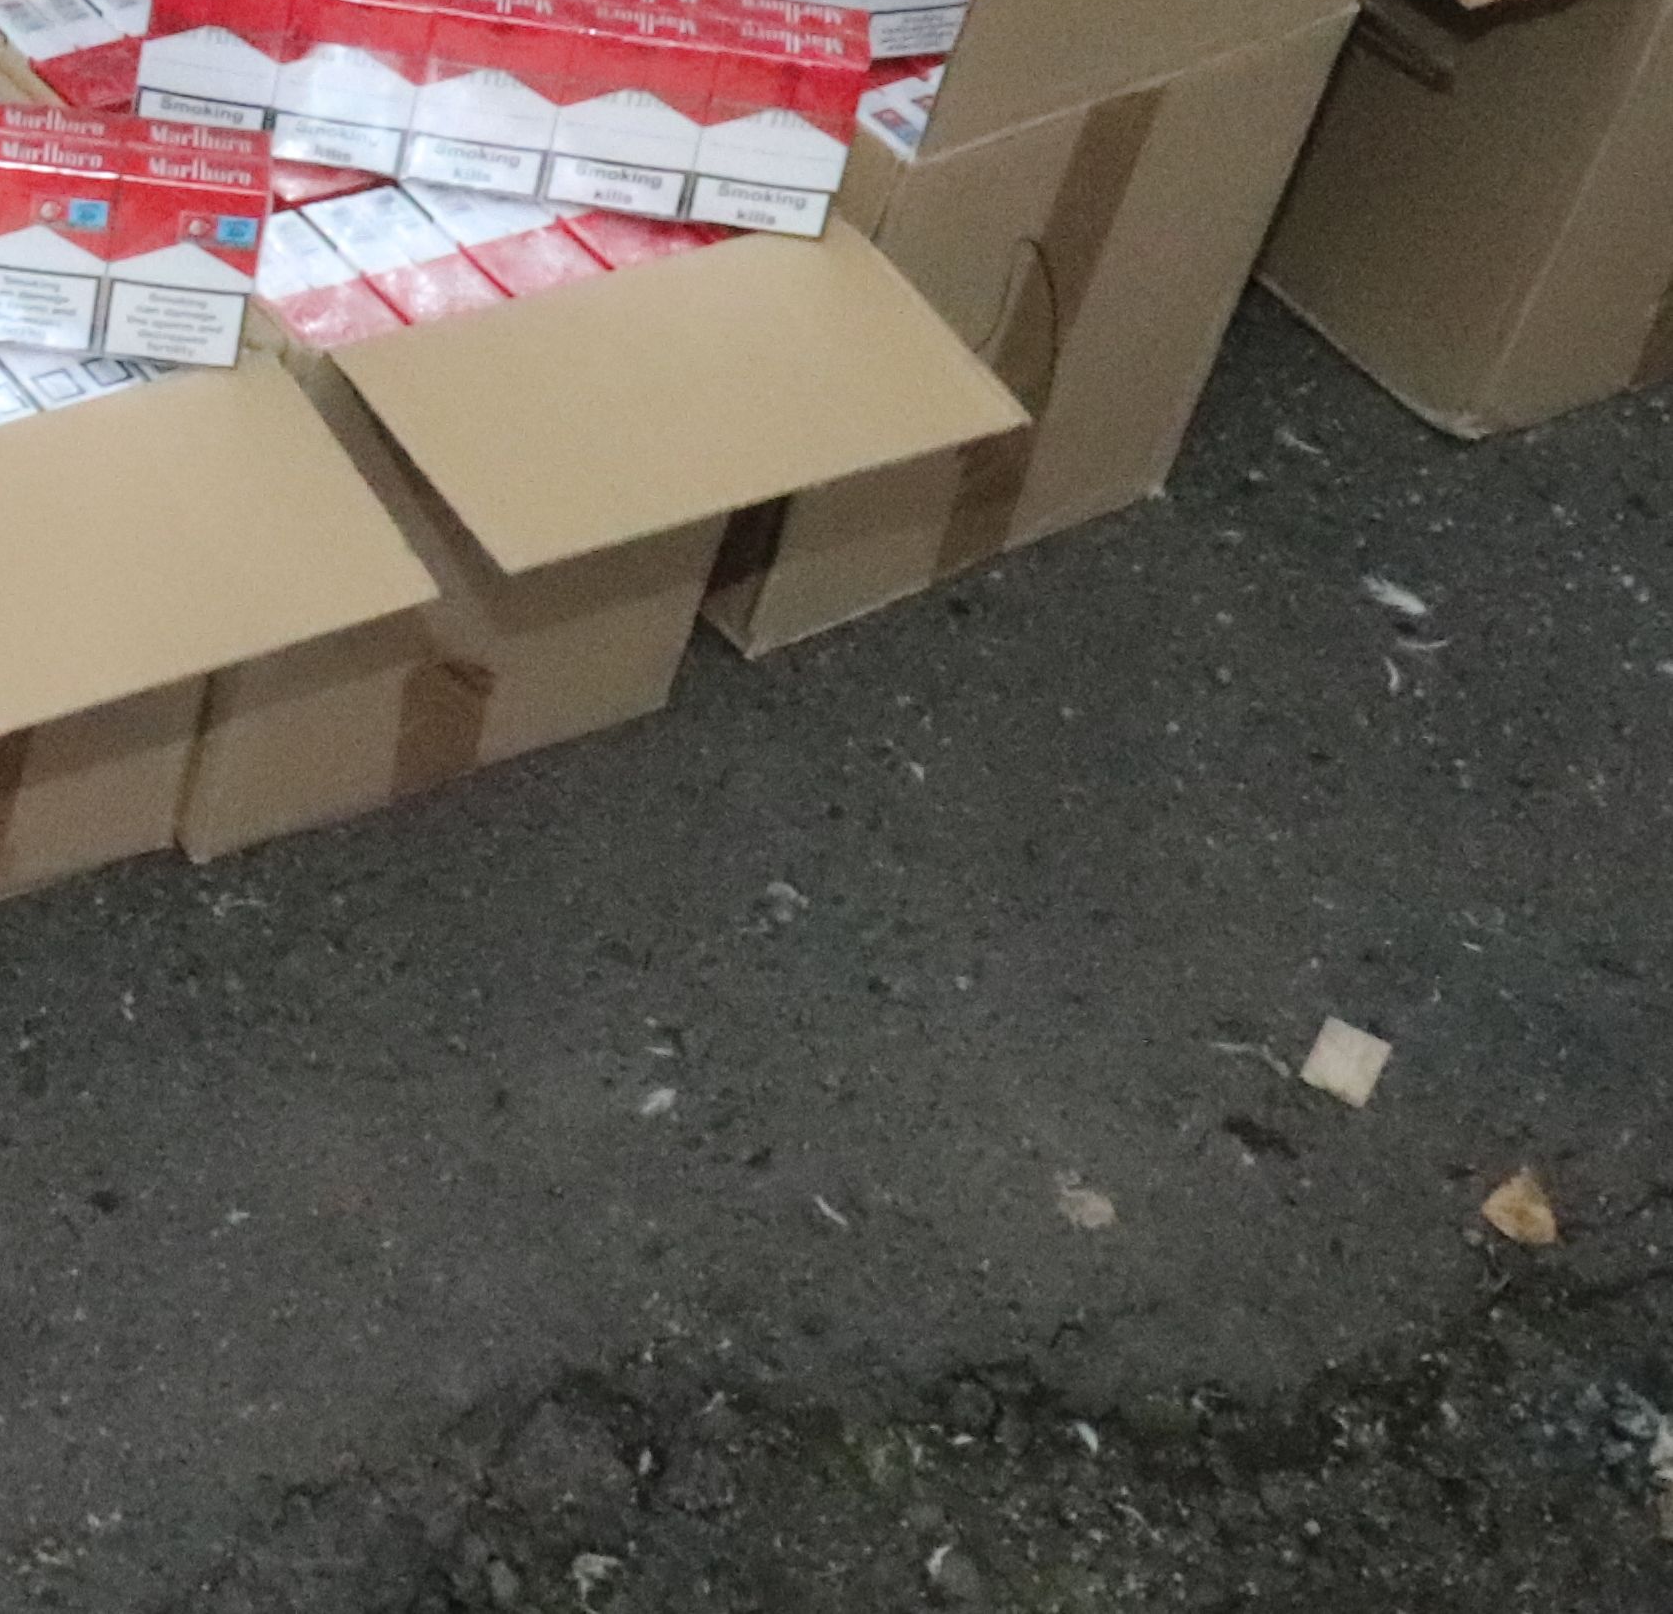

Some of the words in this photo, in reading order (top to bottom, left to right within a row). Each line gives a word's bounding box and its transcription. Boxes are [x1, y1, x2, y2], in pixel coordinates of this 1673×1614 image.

[160, 96, 244, 124] Smoking
[5, 107, 105, 136] Marlboro
[150, 124, 252, 153] Marlboro
[1, 141, 103, 169] Marlboro
[149, 157, 252, 186] Marlboro
[575, 161, 663, 190] Smoking
[717, 181, 807, 210] Smoking
[737, 209, 776, 226] kills
